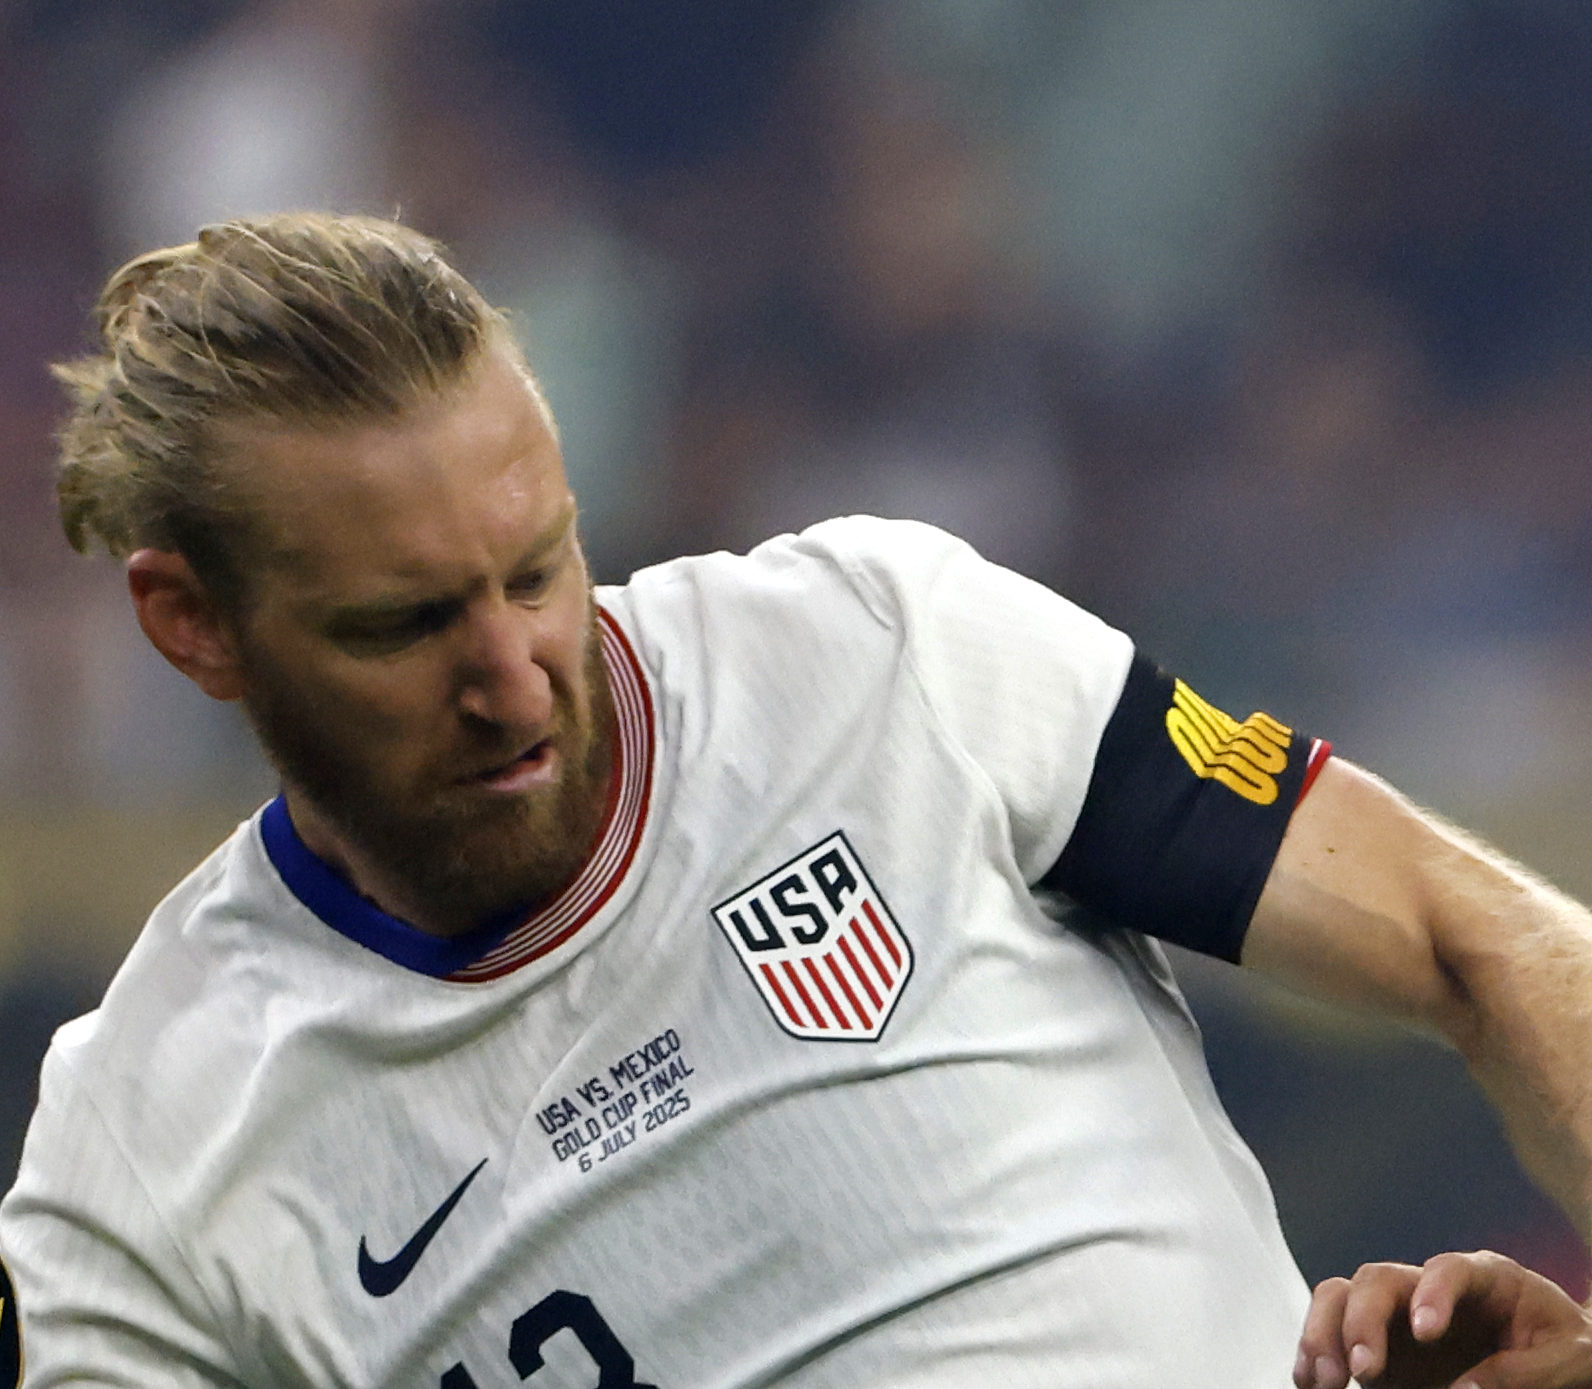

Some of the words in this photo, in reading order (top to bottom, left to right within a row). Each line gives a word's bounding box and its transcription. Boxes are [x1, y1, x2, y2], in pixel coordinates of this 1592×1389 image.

[728, 847, 859, 953] USA
[535, 1096, 582, 1136] USA
[575, 1076, 615, 1108] VS.
[608, 1028, 681, 1090] MEXICO
[551, 1117, 602, 1162] GOLD
[601, 1090, 638, 1130] CUP
[639, 1054, 695, 1105] FINAL
[578, 1151, 593, 1173] 6
[598, 1119, 637, 1163] JULY
[642, 1087, 691, 1133] 2025
